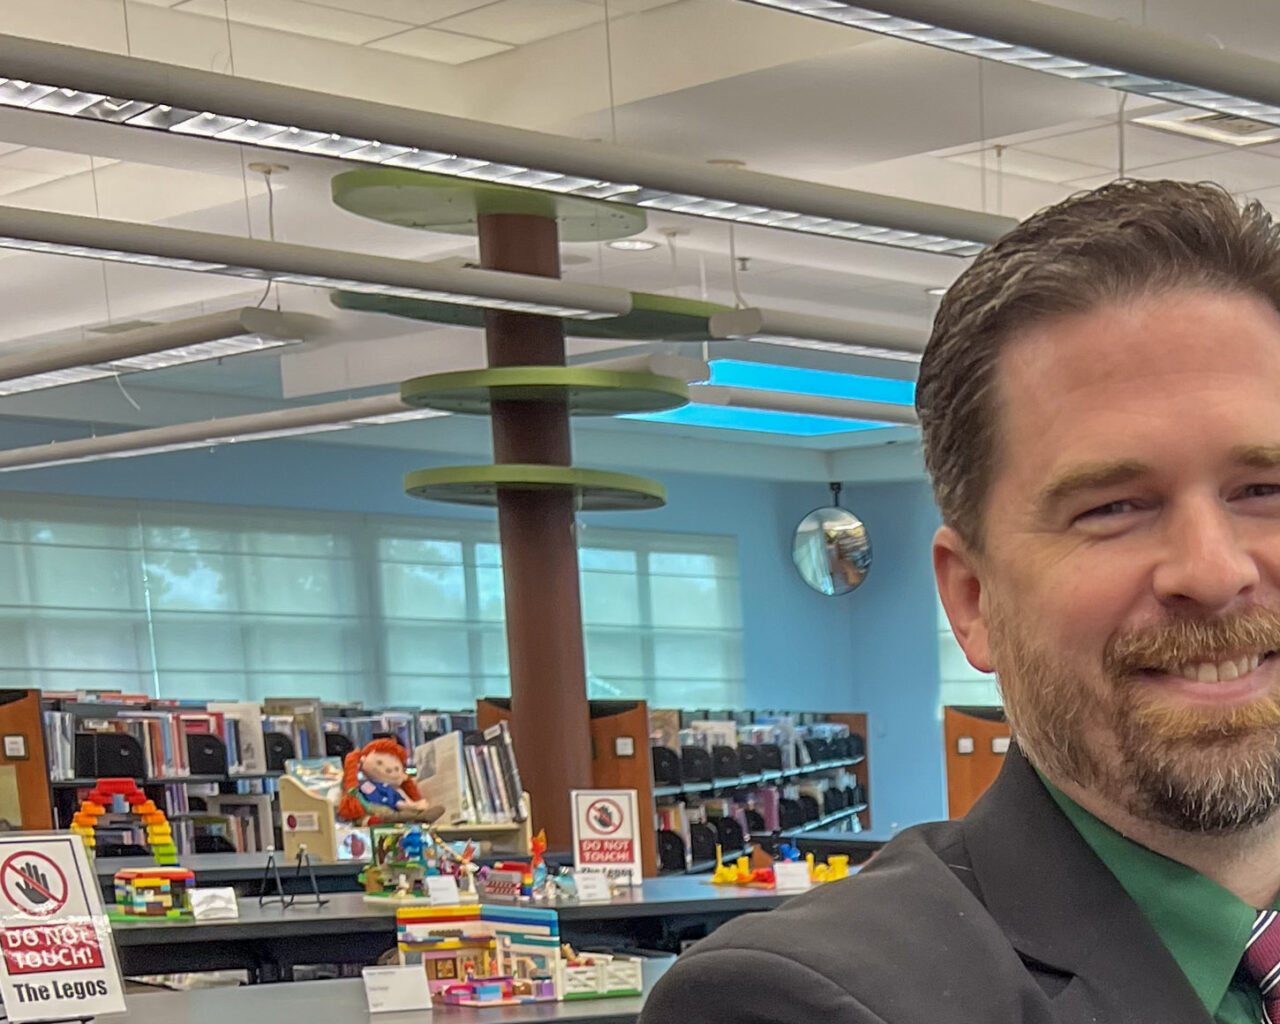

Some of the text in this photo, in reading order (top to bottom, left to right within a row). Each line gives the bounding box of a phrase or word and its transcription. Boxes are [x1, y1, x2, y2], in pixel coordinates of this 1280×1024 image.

[582, 841, 630, 851] DO NOT
[6, 930, 40, 948] DO
[12, 949, 94, 969] TOUCH!
[13, 979, 108, 1003] The Legos
